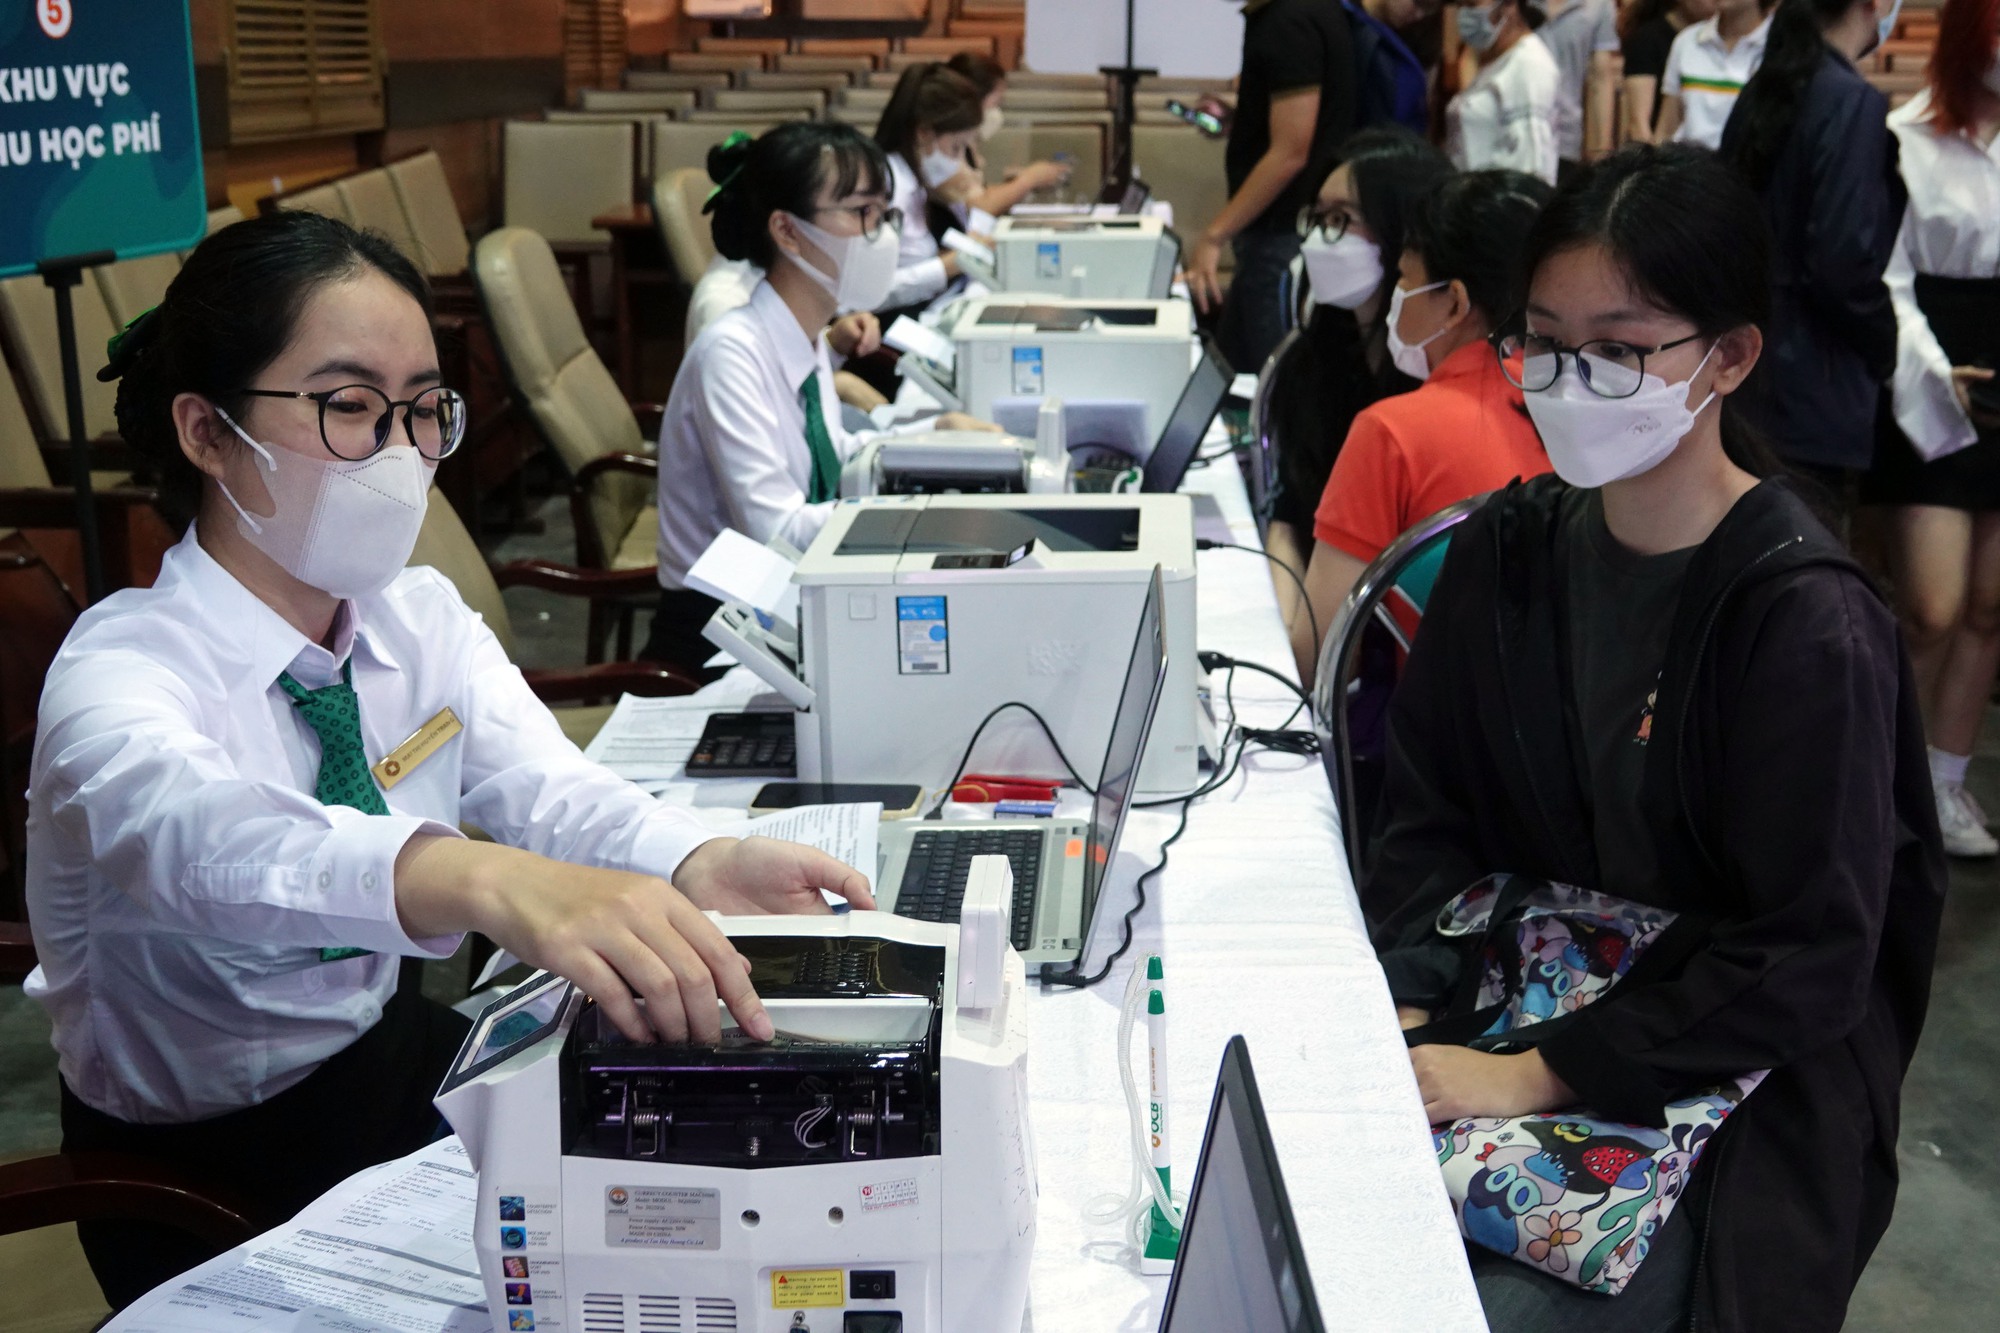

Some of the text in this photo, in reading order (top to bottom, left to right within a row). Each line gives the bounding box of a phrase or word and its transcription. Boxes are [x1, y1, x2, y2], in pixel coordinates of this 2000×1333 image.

[0, 61, 131, 108] KHU VỰC
[38, 123, 106, 171] HỌC
[112, 111, 161, 156] PHÍ
[1150, 1101, 1160, 1134] OCB
